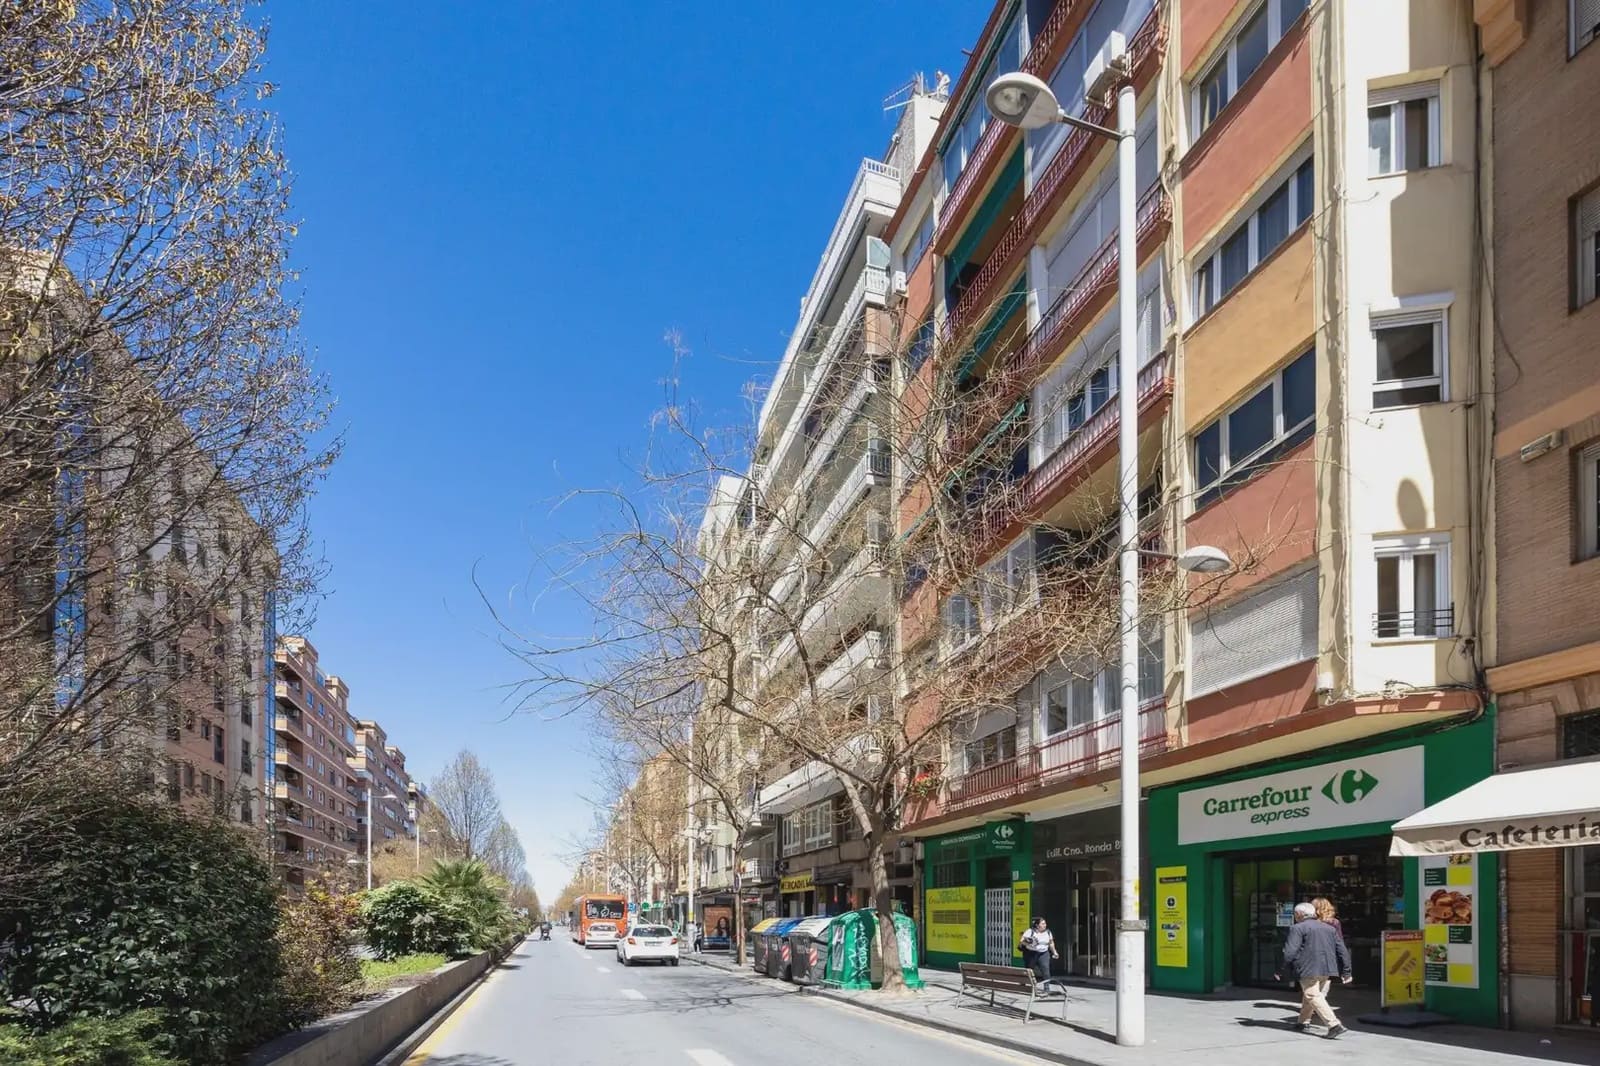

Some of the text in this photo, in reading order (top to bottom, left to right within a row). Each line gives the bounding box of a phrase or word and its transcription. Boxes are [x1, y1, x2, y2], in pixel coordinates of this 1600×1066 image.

[1203, 786, 1312, 816] Carrefour
[1250, 806, 1310, 825] express
[1063, 846, 1083, 857] Cno.
[1085, 841, 1112, 854] Ronda
